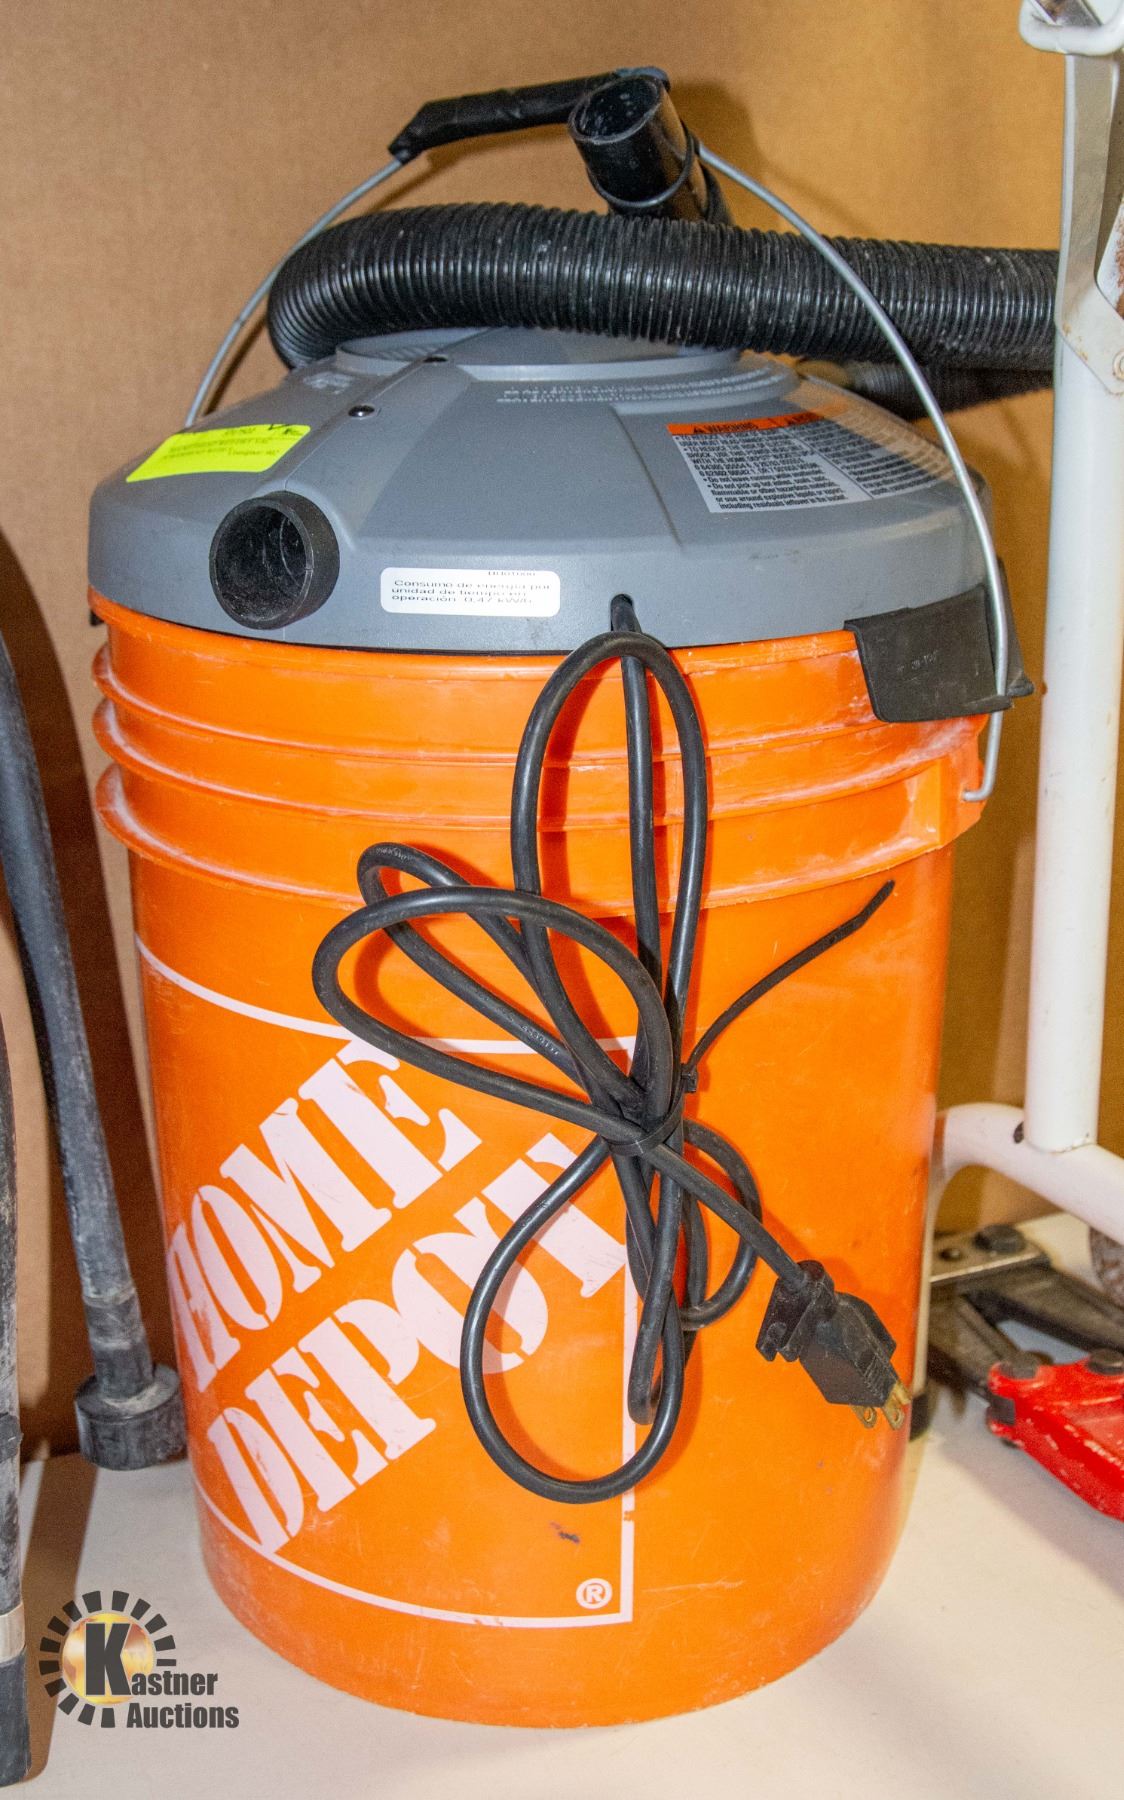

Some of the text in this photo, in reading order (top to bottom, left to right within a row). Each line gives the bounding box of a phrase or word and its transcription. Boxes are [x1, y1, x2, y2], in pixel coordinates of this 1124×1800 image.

[394, 580, 454, 588] Consumo
[166, 1037, 482, 1393] HOME
[207, 1131, 627, 1554] DEPOT
